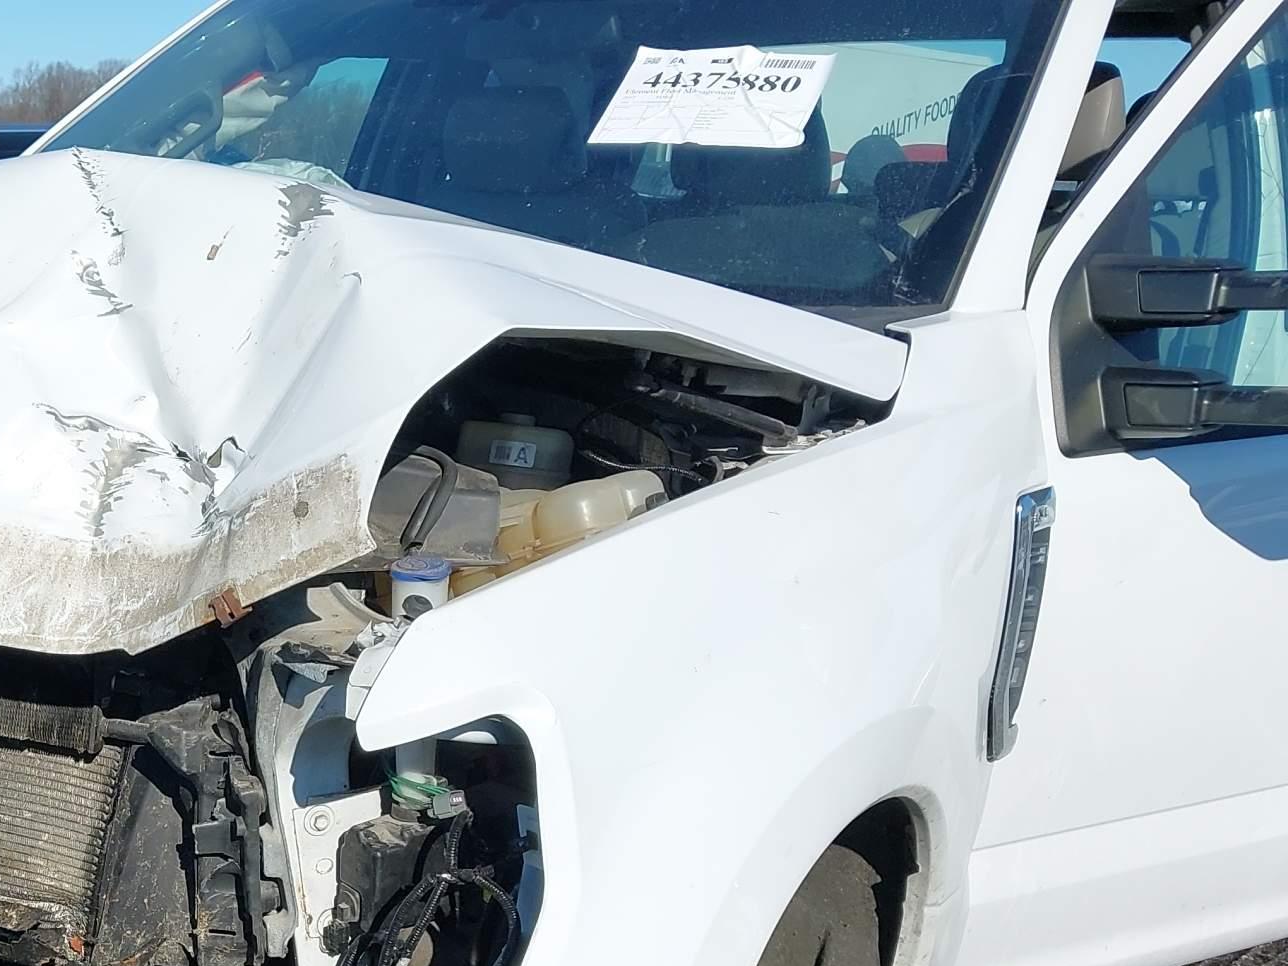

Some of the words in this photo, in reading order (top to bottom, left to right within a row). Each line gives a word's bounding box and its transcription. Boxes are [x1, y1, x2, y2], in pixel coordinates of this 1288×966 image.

[642, 70, 802, 93] 44375880
[924, 92, 961, 126] FOOD
[513, 446, 528, 464] A
